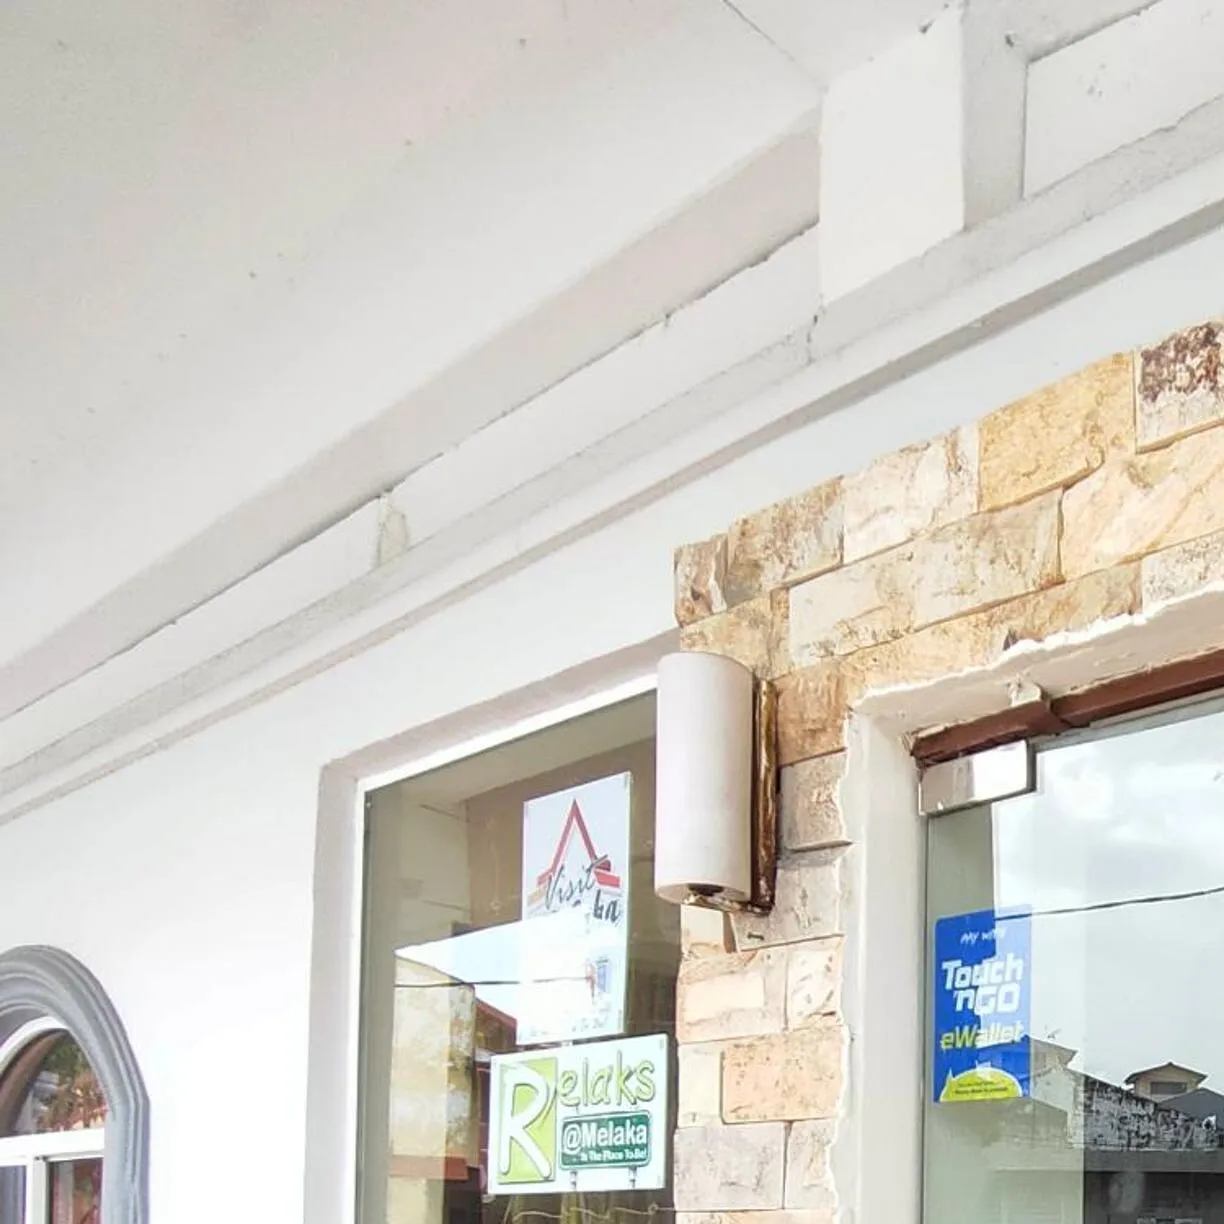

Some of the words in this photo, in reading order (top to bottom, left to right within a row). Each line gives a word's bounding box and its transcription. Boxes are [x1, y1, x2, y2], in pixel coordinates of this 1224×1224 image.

[545, 854, 608, 910] Visit
[941, 952, 1023, 990] Touch
[940, 1020, 1024, 1050] eWallet
[501, 1050, 656, 1179] Relaks
[563, 1119, 647, 1155] @Melaka
